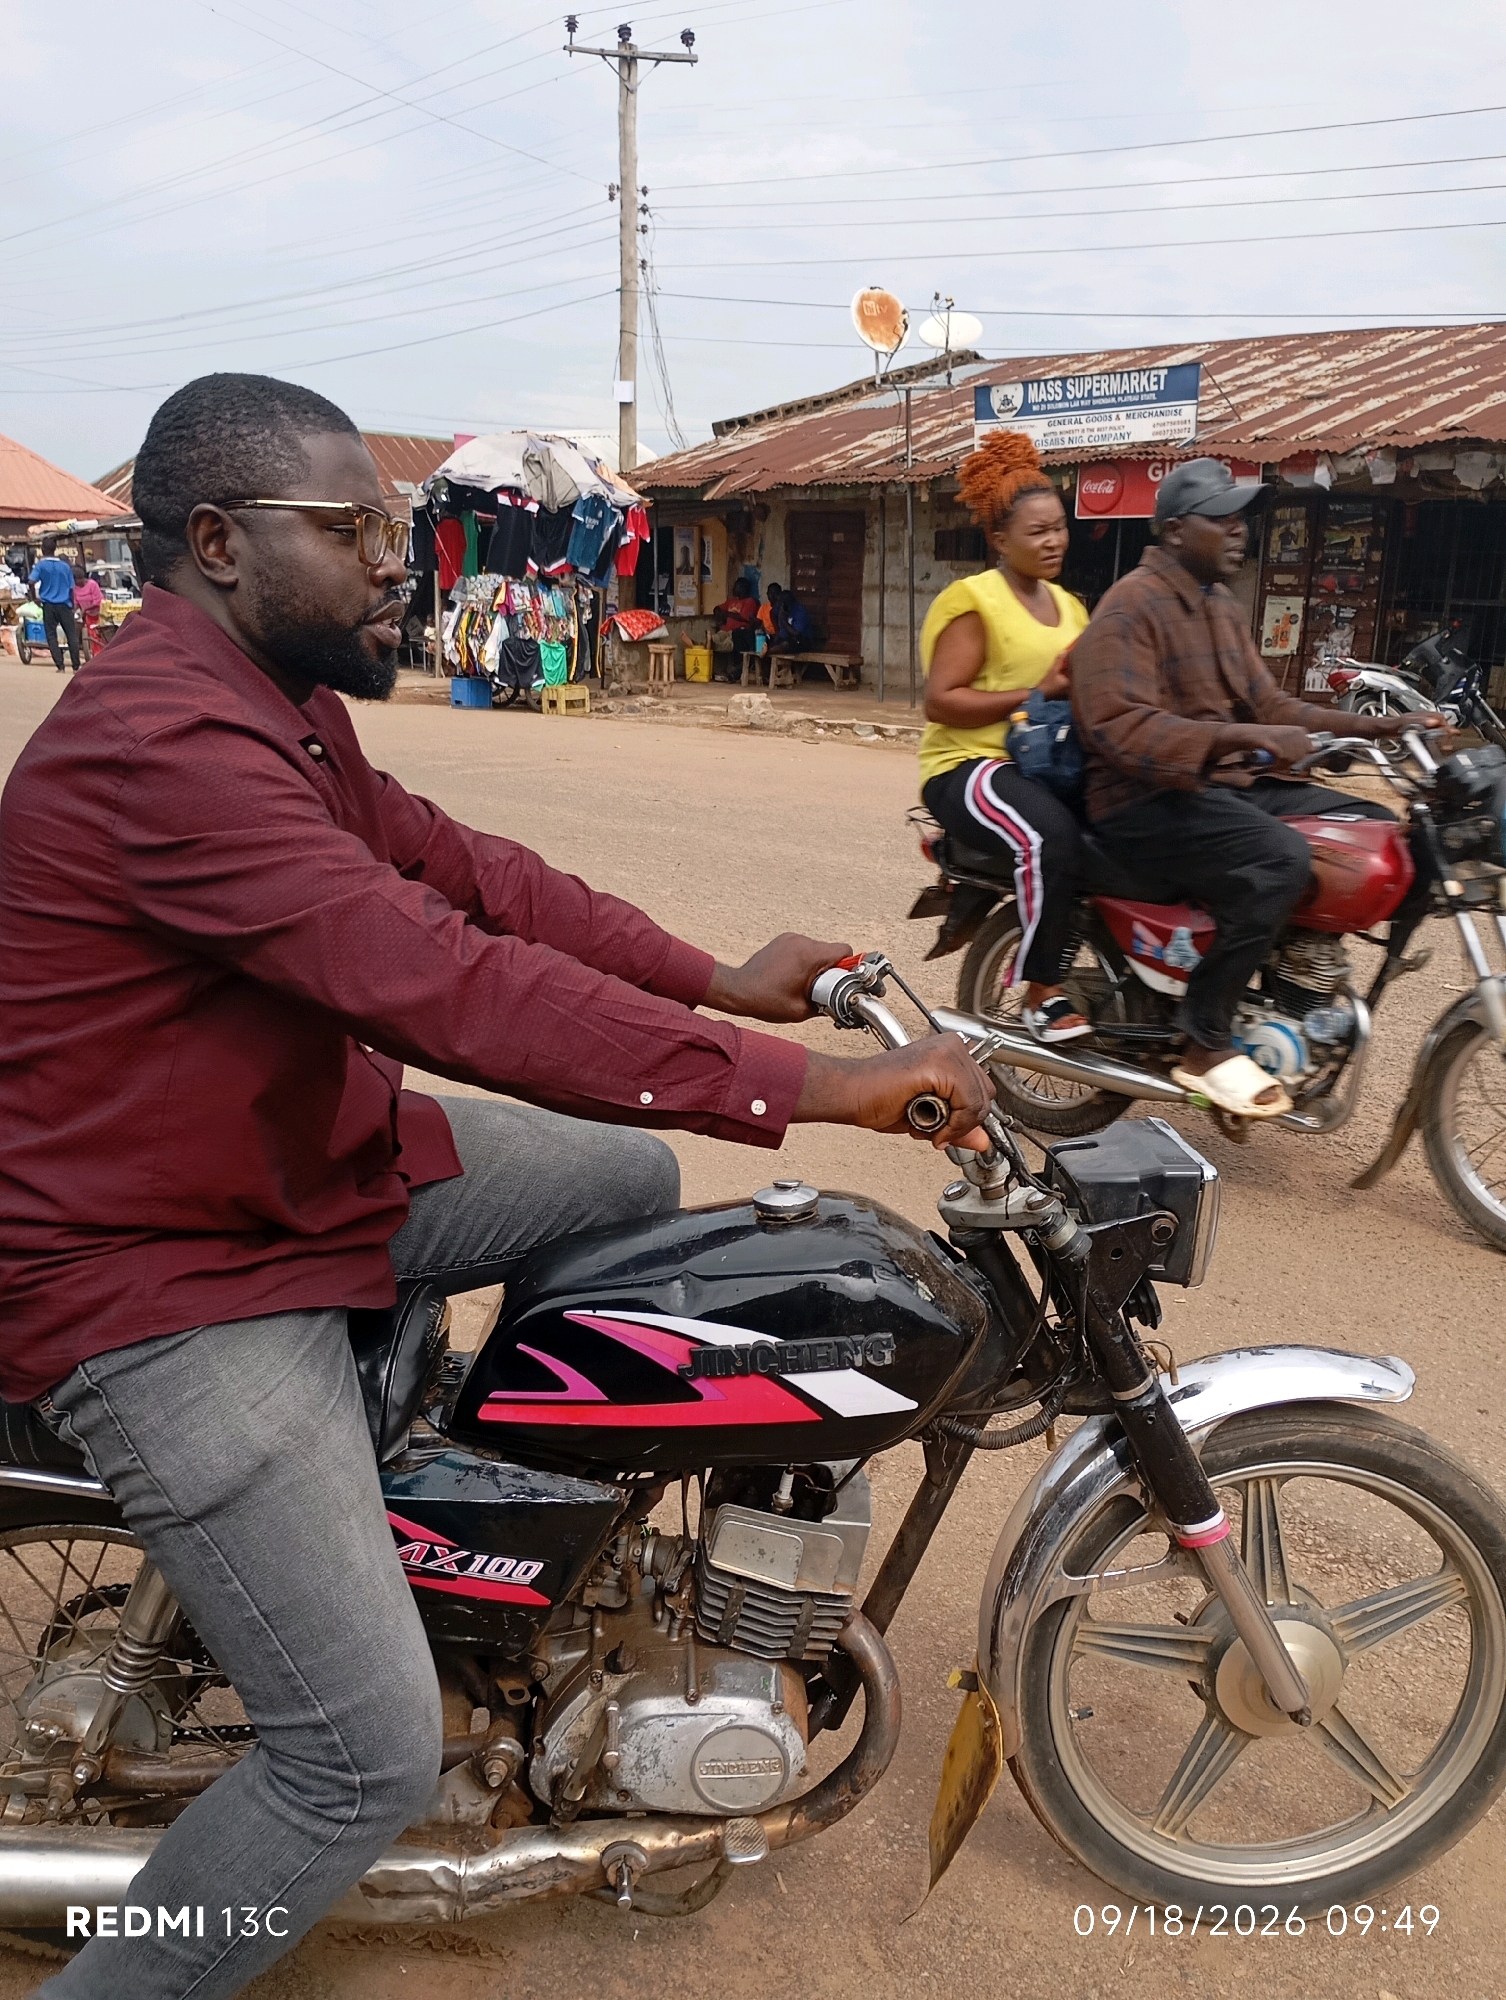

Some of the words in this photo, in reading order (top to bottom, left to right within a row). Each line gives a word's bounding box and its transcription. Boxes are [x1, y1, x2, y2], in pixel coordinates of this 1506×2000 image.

[1028, 379, 1063, 404] MASS
[1066, 368, 1168, 400] SUPERMARKET
[1047, 417, 1083, 428] GENERAL
[1085, 413, 1113, 424] GOODS
[1115, 413, 1121, 421] &
[1125, 408, 1183, 420] MERCHANDISE
[1034, 437, 1066, 448] GISABS
[1068, 435, 1086, 445] NIG.
[1087, 431, 1132, 444] COMPANY
[678, 1331, 896, 1380] JINCHENG
[397, 1541, 545, 1581] AX100
[700, 1758, 780, 1776] JINCHENG
